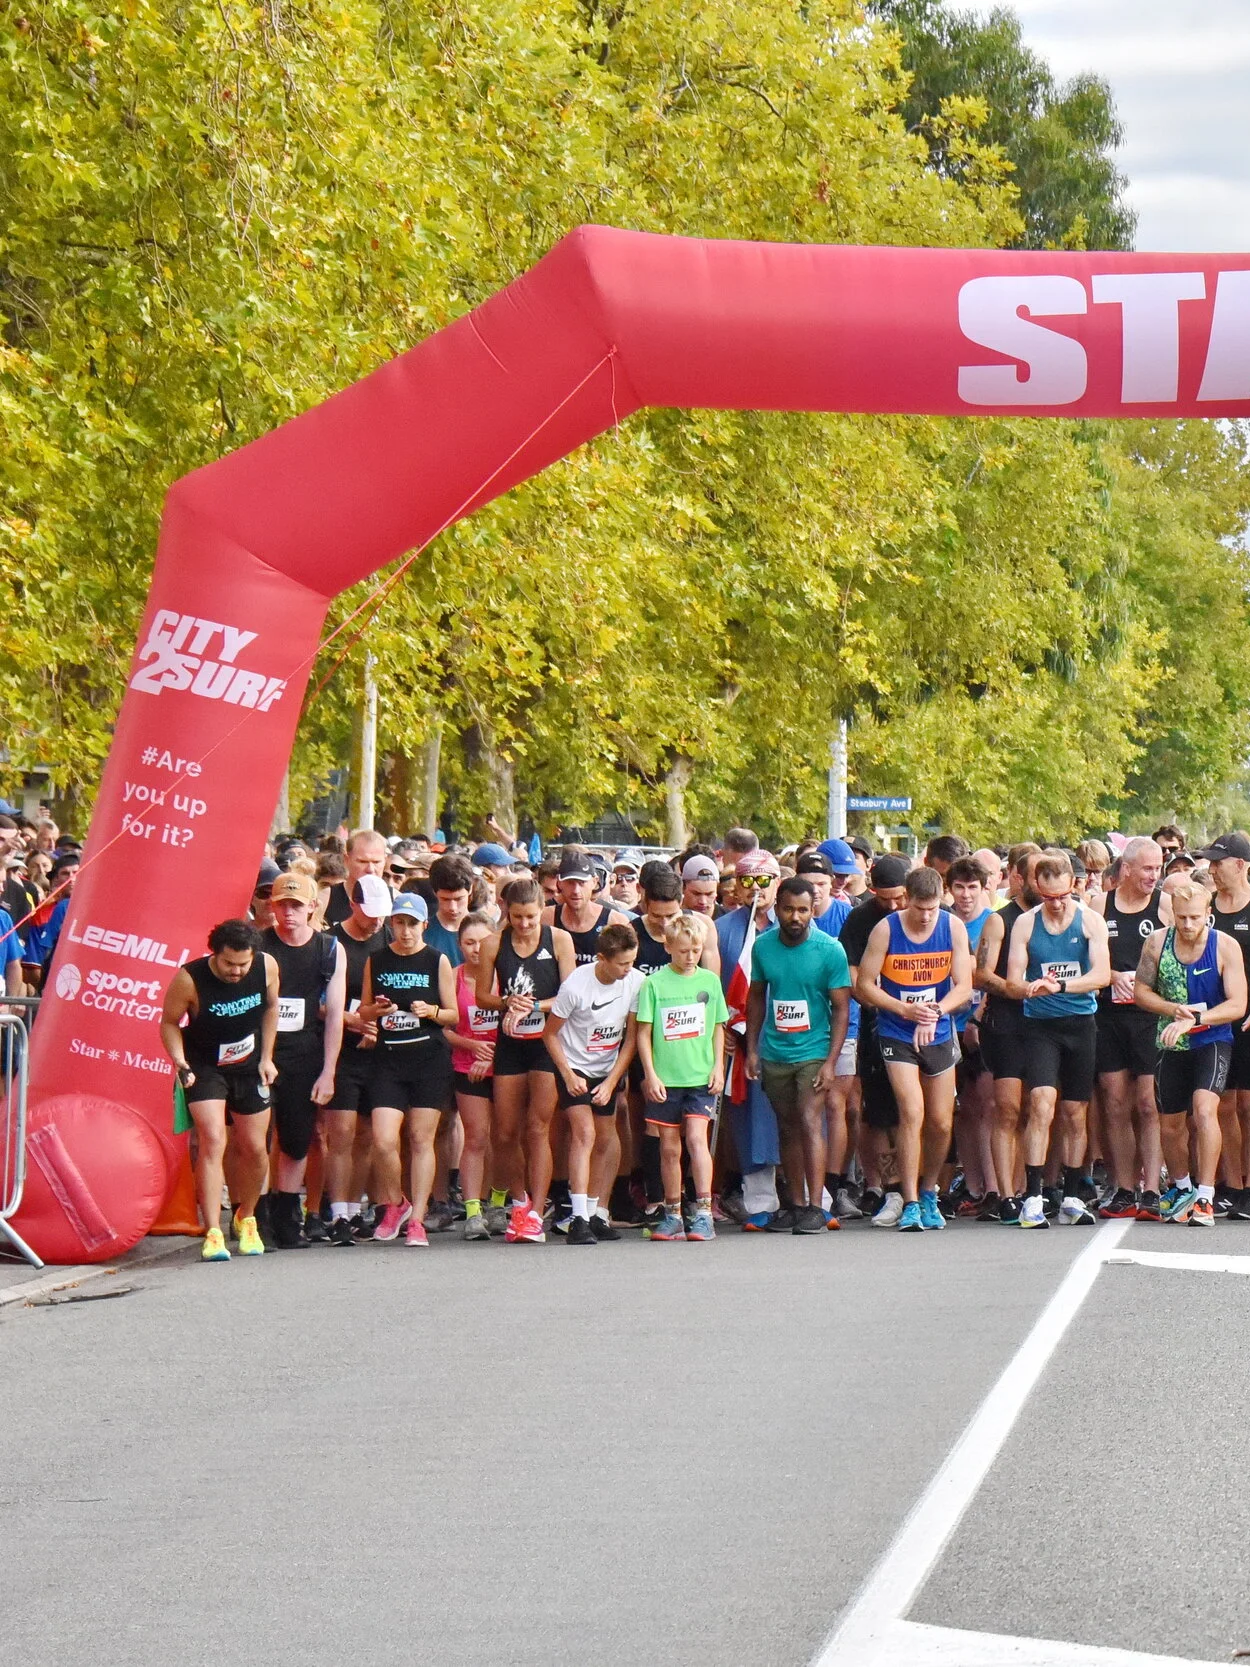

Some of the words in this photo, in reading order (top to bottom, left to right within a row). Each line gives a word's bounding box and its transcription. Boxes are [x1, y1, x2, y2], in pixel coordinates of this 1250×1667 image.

[147, 609, 259, 663] CITY
[142, 746, 202, 777] #Are
[124, 781, 165, 806] you
[172, 793, 208, 819] up
[850, 798, 888, 810] Stanbury
[891, 798, 907, 808] Ave
[122, 813, 156, 839] for
[162, 824, 194, 848] it?
[893, 957, 950, 970] CHRISTCHURCH
[1048, 964, 1069, 972] CITY
[388, 973, 430, 981] ANYTIME
[913, 970, 933, 982] AVON
[86, 969, 162, 1001] sport
[388, 979, 430, 988] FITNESS
[223, 993, 262, 1011] ANYTIME
[81, 990, 190, 1028] canter
[667, 1010, 688, 1020] CITY
[387, 1015, 406, 1024] CITY
[472, 1014, 499, 1025] 2SU
[776, 1010, 805, 1021] 2SURF
[385, 1020, 416, 1030] 2SURF
[518, 1017, 543, 1027] SURF
[666, 1016, 697, 1029] 2SURF
[590, 1031, 620, 1041] 2SURF
[594, 1027, 615, 1036] CITY
[70, 1038, 105, 1060] Star
[122, 1051, 173, 1074] Media
